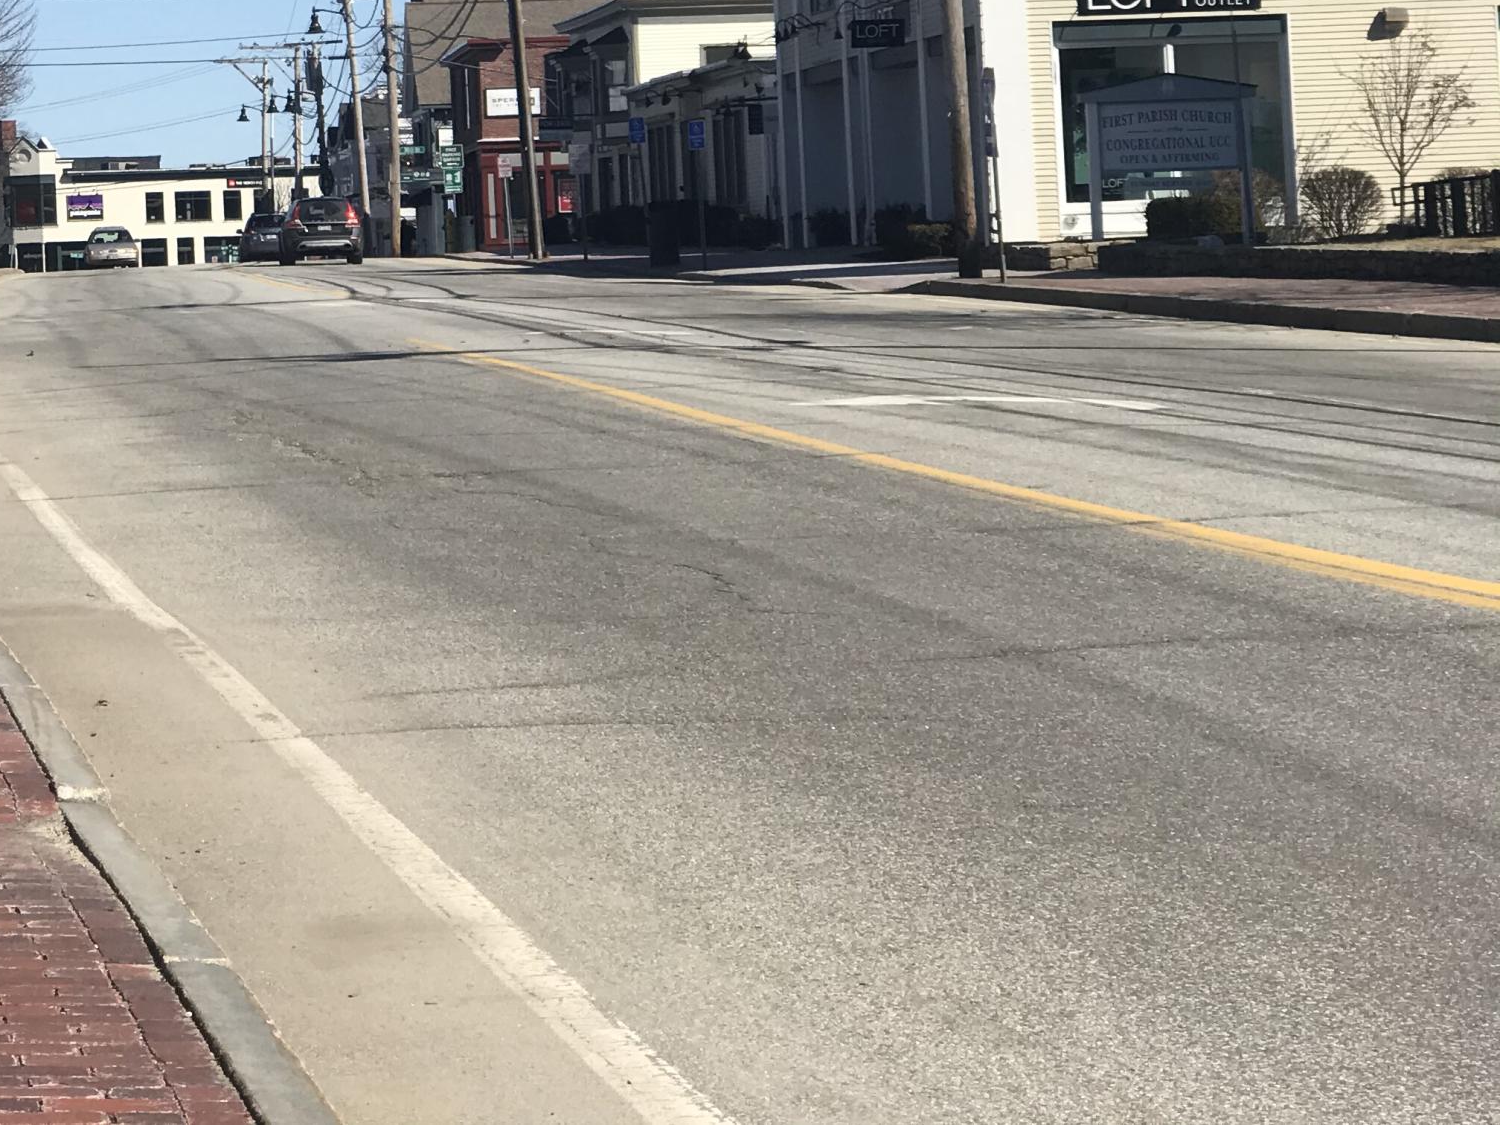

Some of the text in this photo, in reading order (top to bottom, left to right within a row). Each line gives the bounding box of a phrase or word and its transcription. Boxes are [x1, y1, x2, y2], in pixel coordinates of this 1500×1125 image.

[856, 24, 900, 38] LOFT
[1102, 110, 1232, 129] FIRST PARISH CHURCH
[1106, 136, 1232, 151] CONGREGATIONAL UCC
[1120, 153, 1220, 164] OPEN & AFFIRMING
